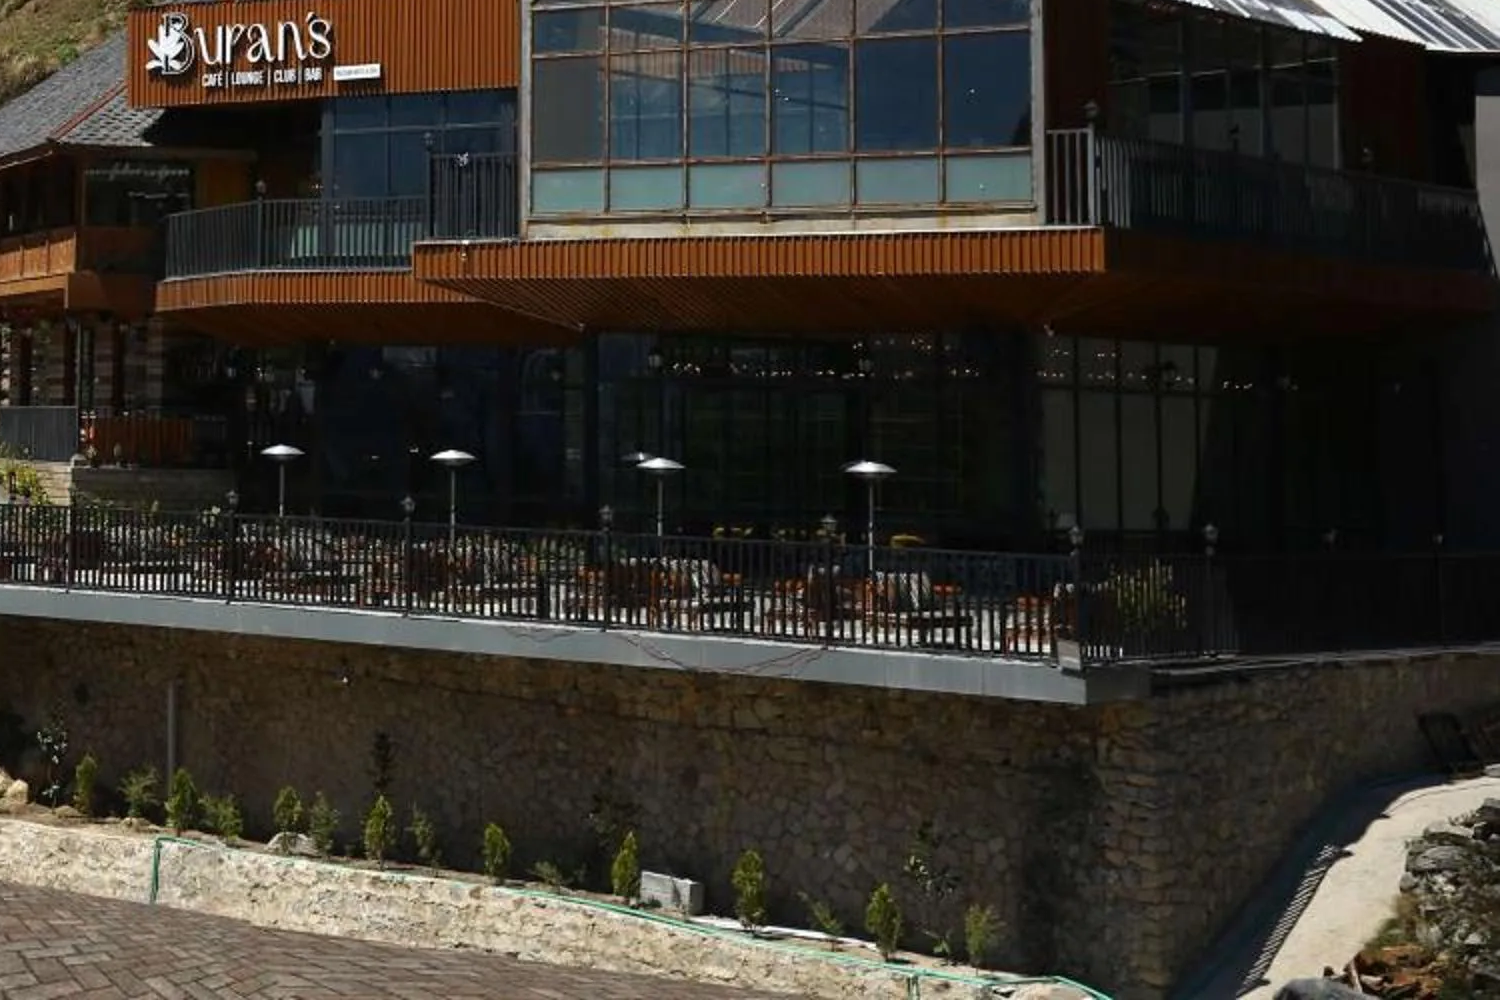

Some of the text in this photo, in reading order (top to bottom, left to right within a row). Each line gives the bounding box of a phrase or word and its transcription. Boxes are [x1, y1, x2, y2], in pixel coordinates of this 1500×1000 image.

[160, 11, 332, 75] Buran's
[231, 71, 264, 86] LOUNGE
[273, 68, 296, 84] CLUB
[304, 66, 323, 82] BAR
